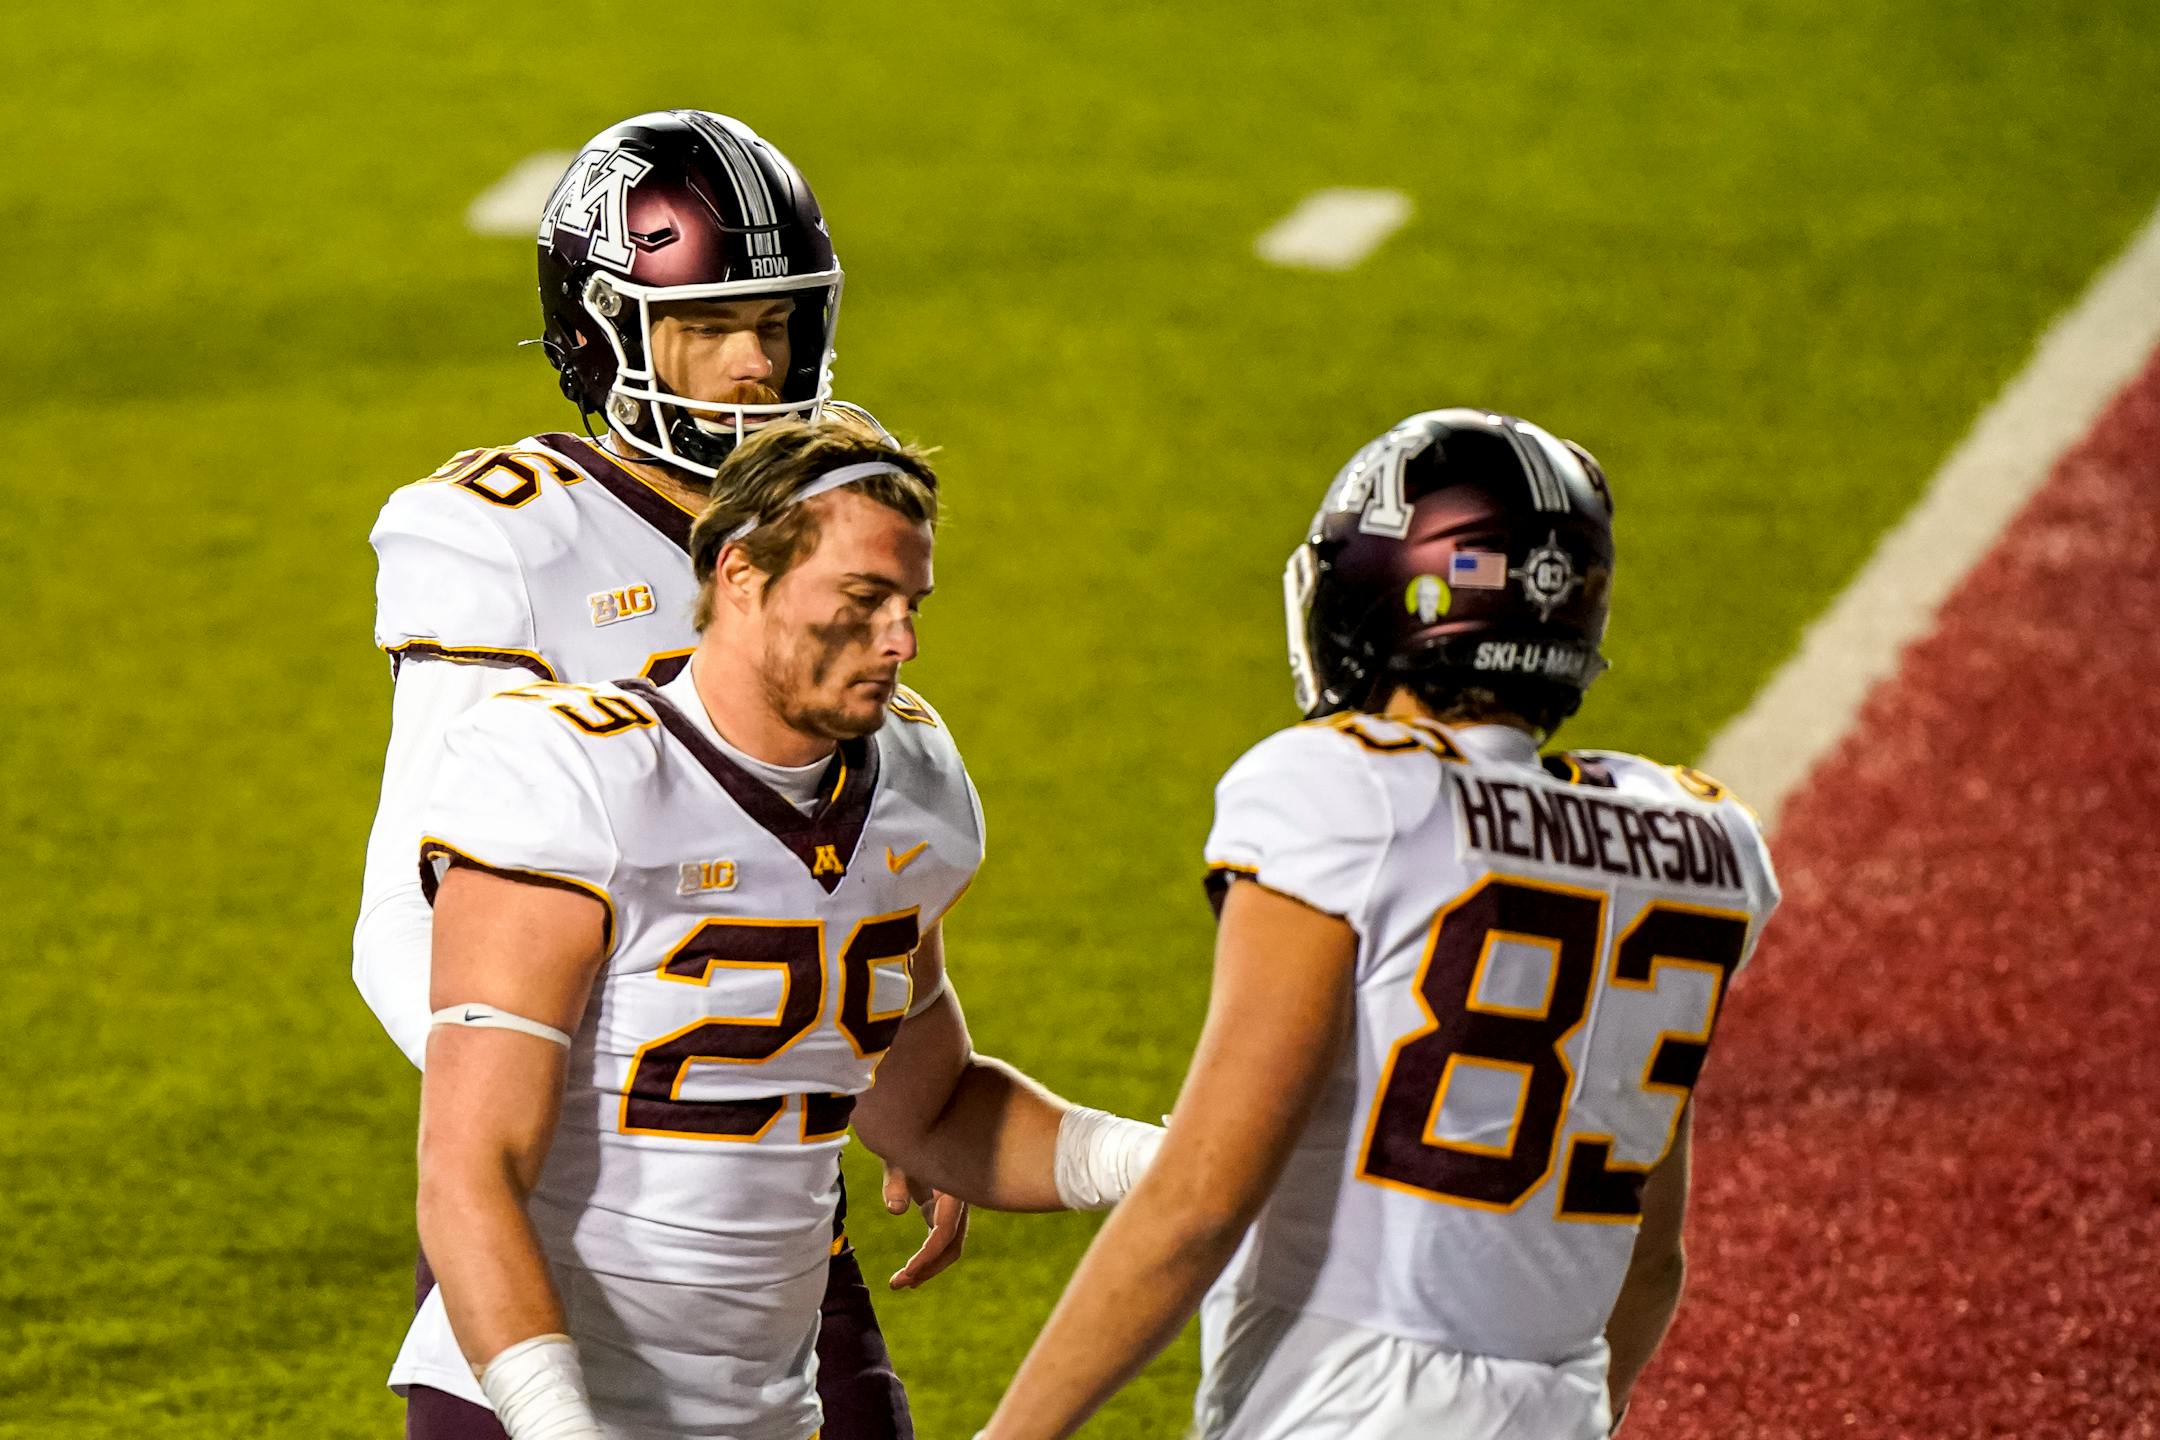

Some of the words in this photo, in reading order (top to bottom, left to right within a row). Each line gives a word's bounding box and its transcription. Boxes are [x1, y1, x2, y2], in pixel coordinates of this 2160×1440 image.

[537, 149, 654, 275] M
[751, 256, 789, 278] ROW
[812, 844, 845, 876] M
[1453, 774, 1743, 890] HENDERSON
[618, 904, 921, 1144] 29
[1354, 872, 1750, 1225] 83
